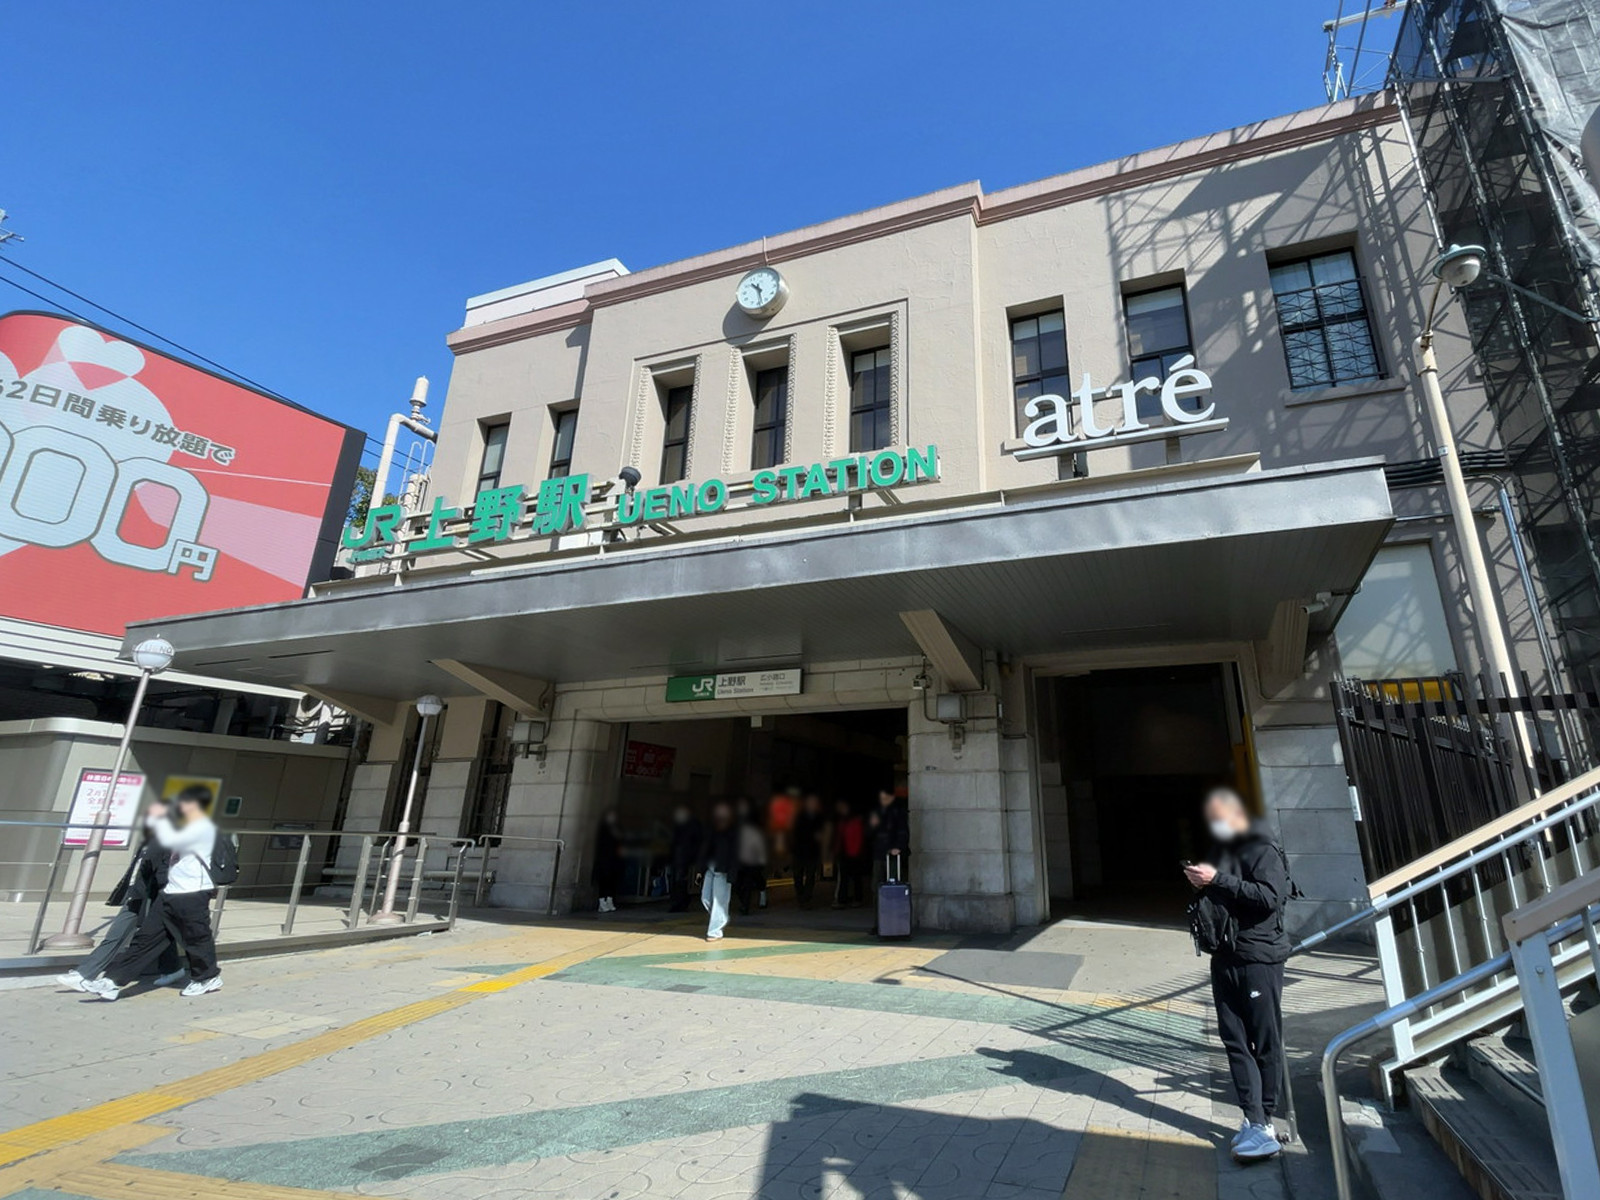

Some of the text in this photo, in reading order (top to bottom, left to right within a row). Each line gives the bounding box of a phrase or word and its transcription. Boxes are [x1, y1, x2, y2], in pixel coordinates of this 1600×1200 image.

[0, 379, 235, 465] 2日間乗り放題で
[1023, 354, 1216, 447] atré
[0, 418, 220, 583] 00円
[617, 478, 727, 524] UENO
[752, 444, 938, 504] STATION
[692, 678, 714, 692] JR
[718, 676, 746, 688] 上野駅
